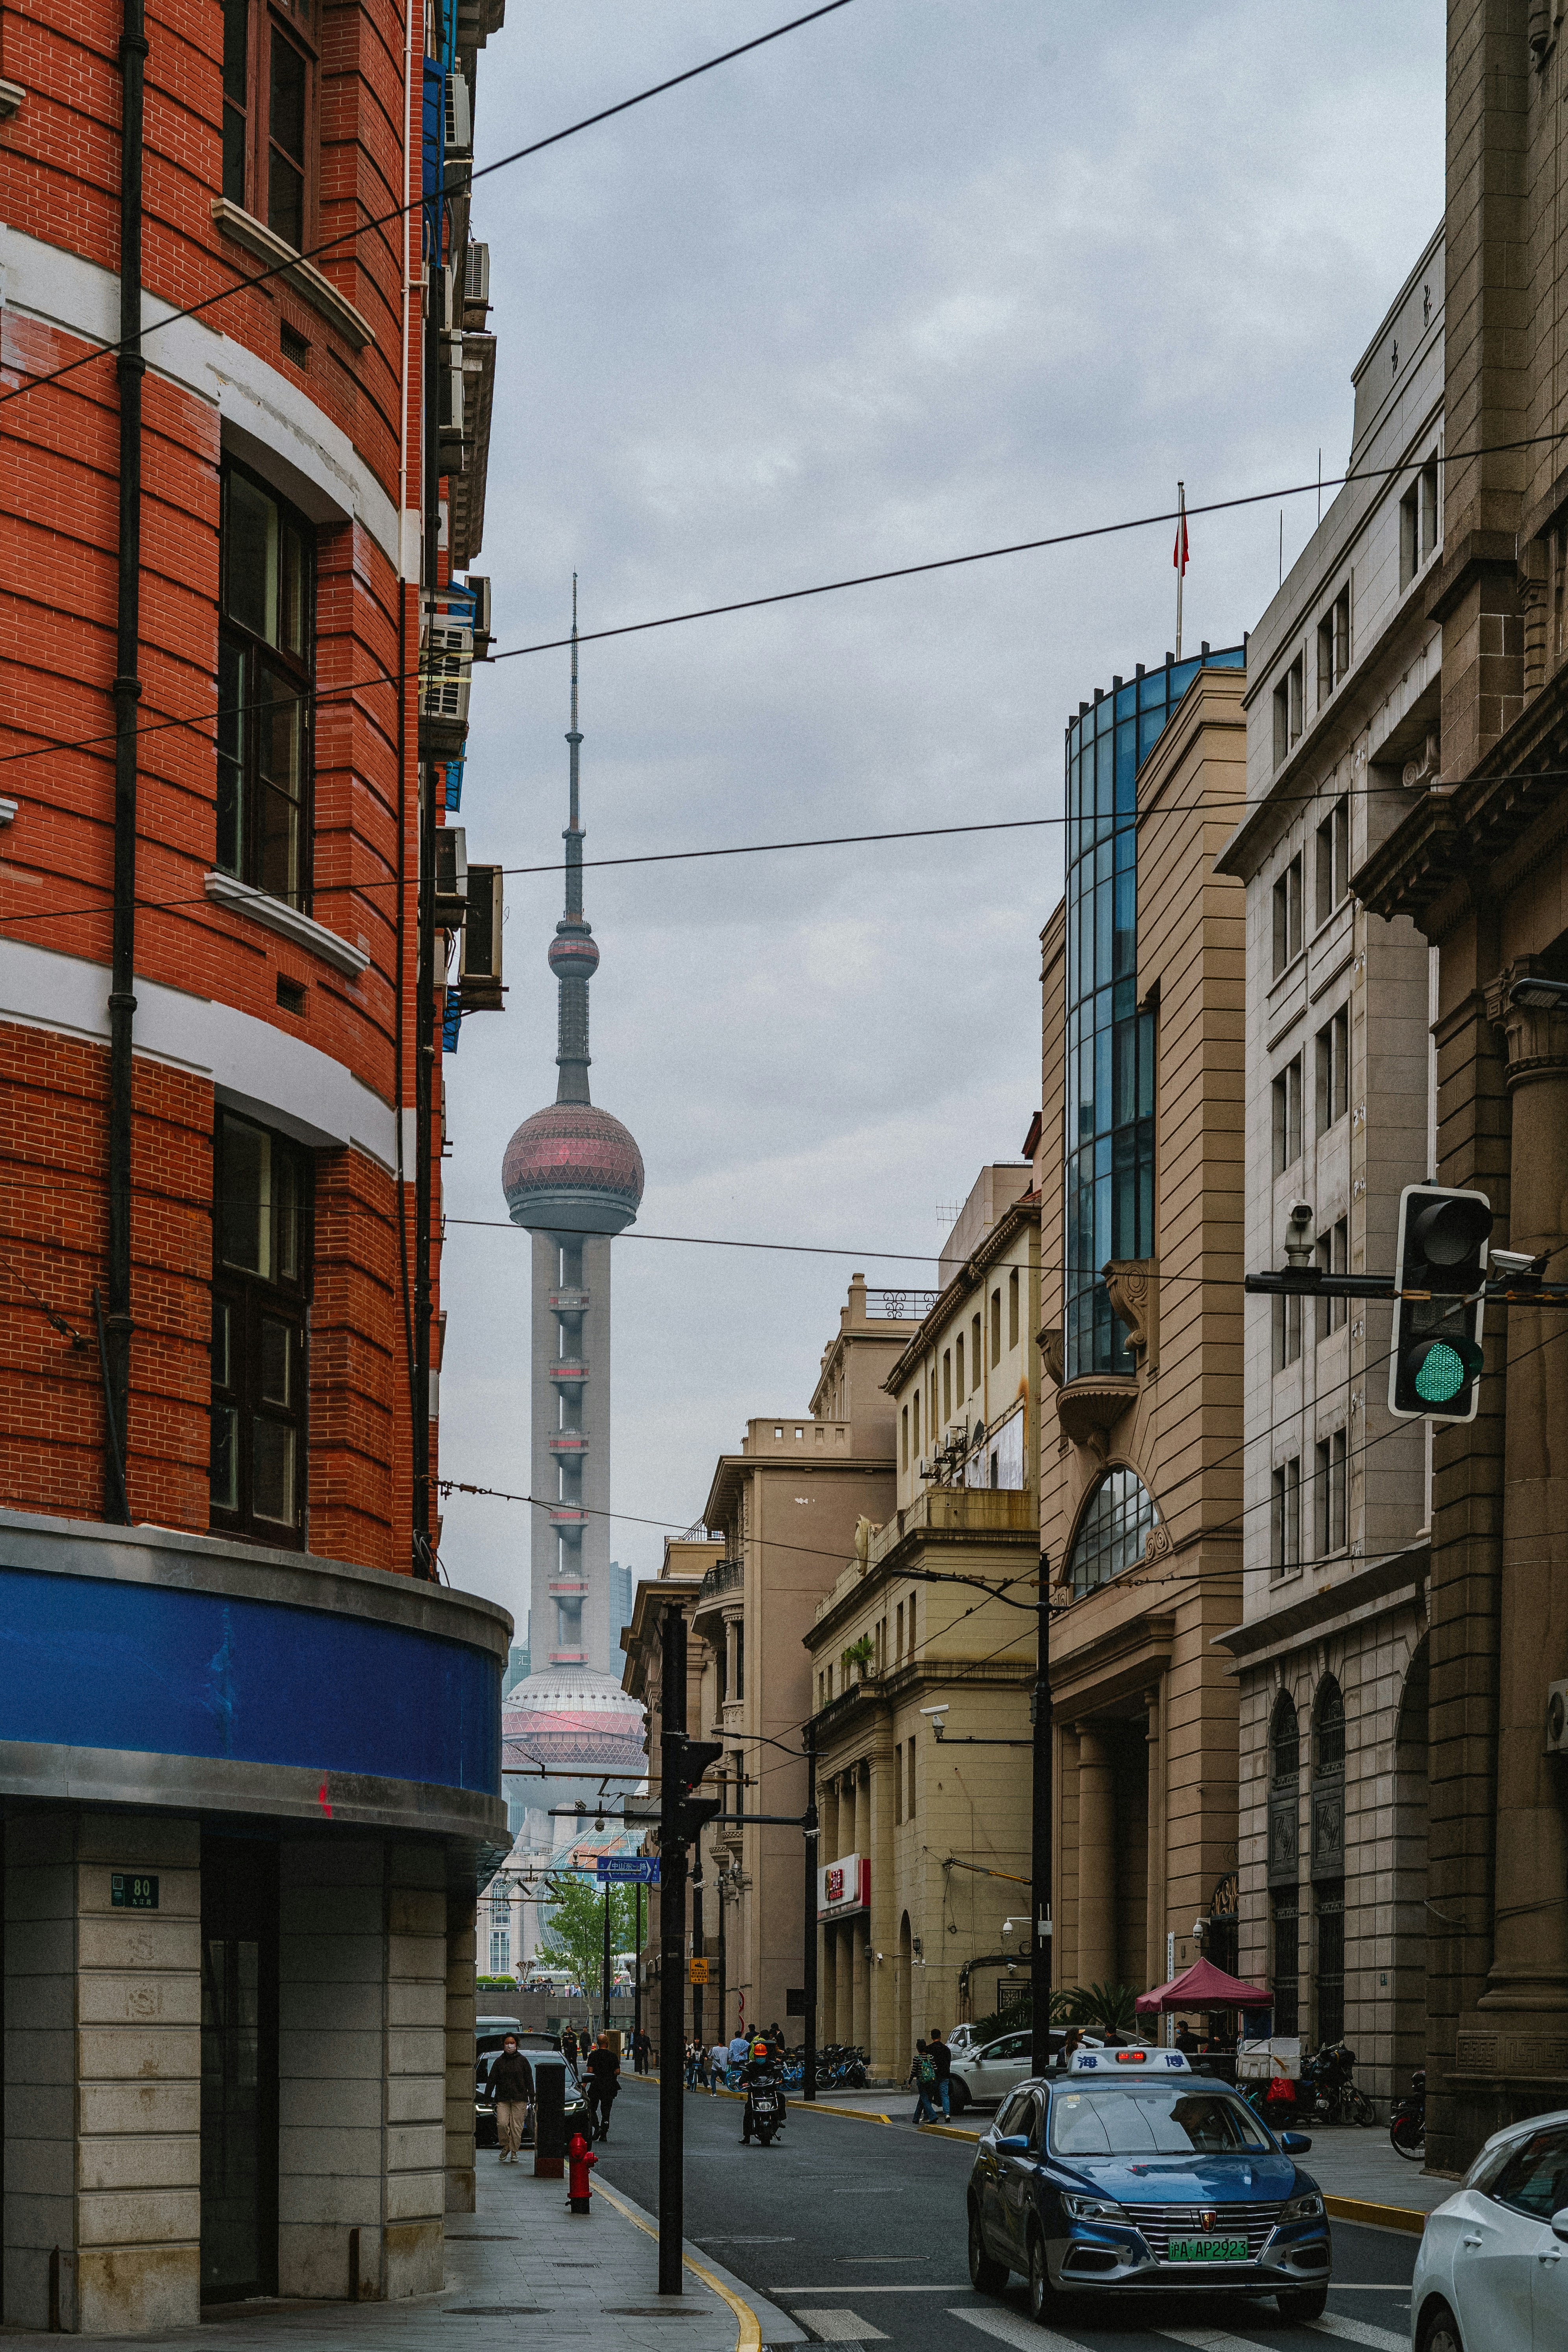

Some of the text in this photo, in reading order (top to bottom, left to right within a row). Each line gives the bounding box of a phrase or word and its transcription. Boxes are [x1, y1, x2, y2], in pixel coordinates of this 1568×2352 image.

[134, 1879, 150, 1896] 80
[1077, 2055, 1184, 2069] 海 博
[1195, 2240, 1246, 2258] AP2923
